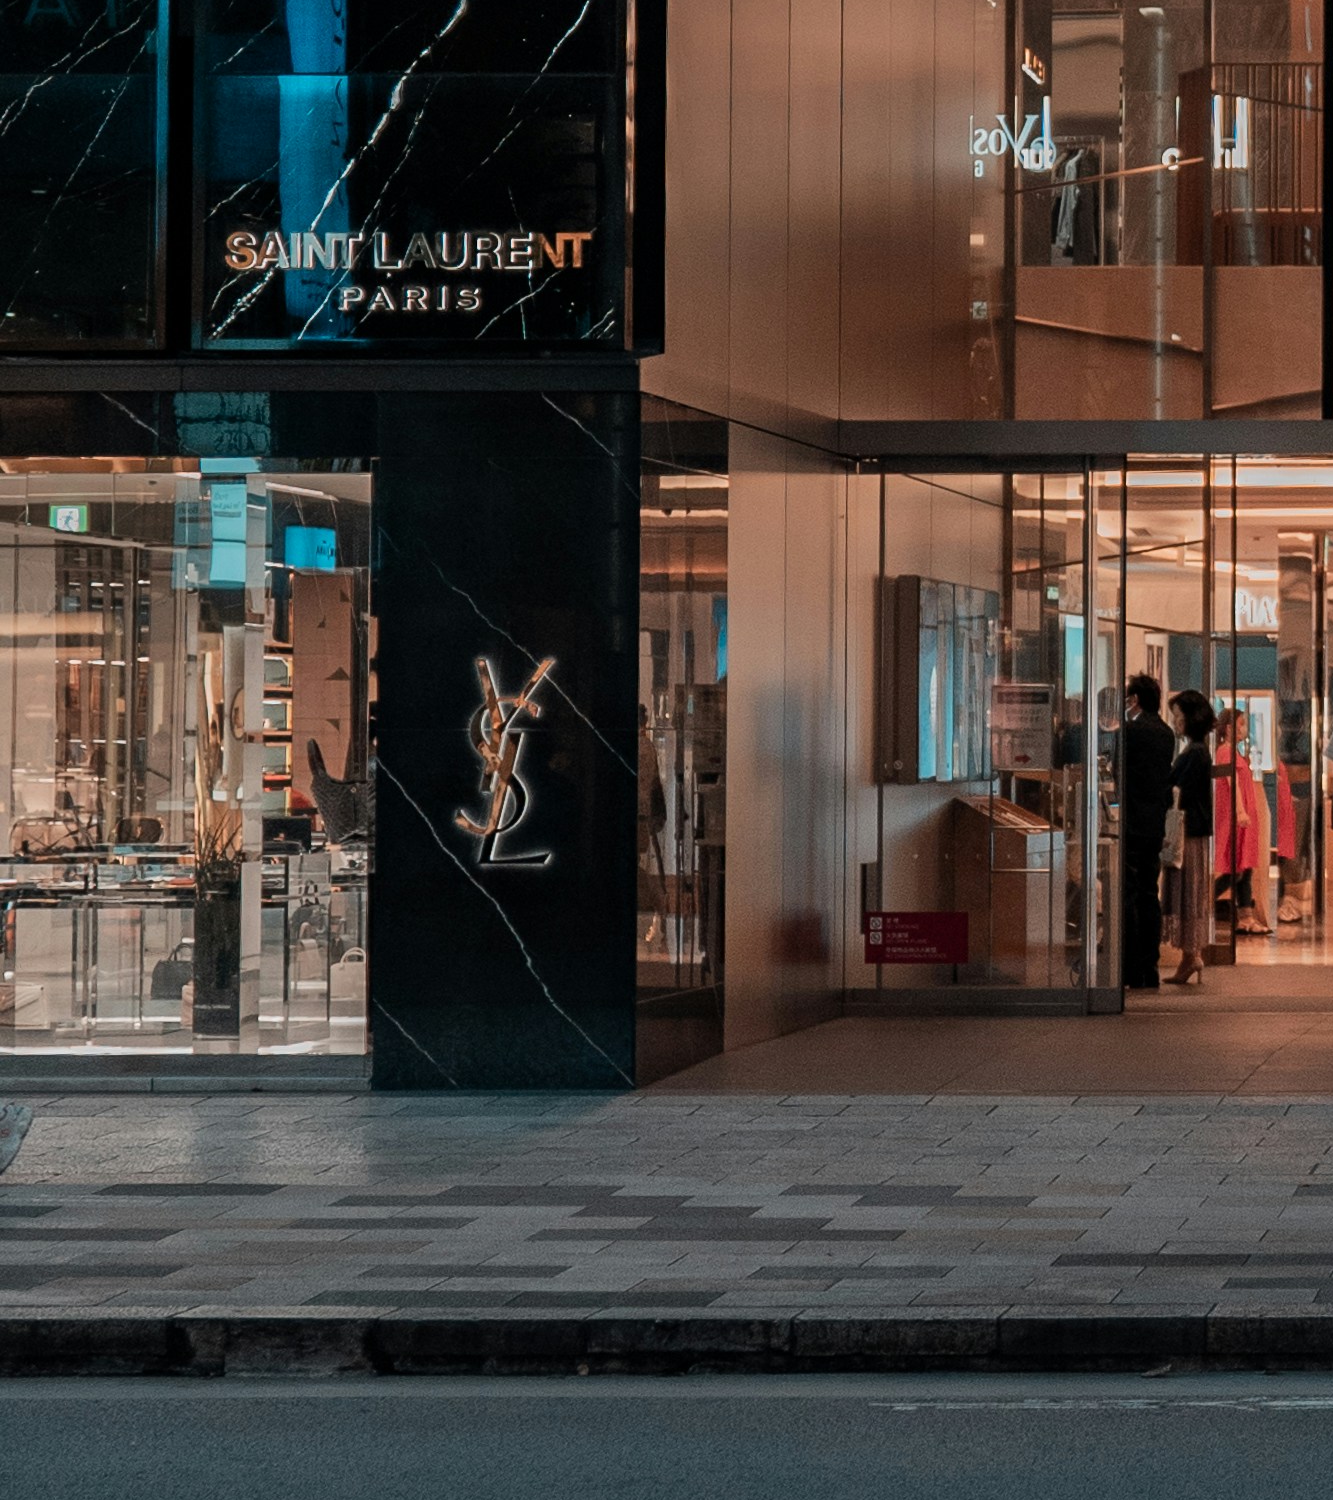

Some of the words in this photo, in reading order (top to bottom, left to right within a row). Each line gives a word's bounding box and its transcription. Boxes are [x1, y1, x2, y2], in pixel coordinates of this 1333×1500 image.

[224, 230, 365, 270] SAINT
[373, 231, 593, 270] LAURENT
[338, 285, 483, 311] PARIS
